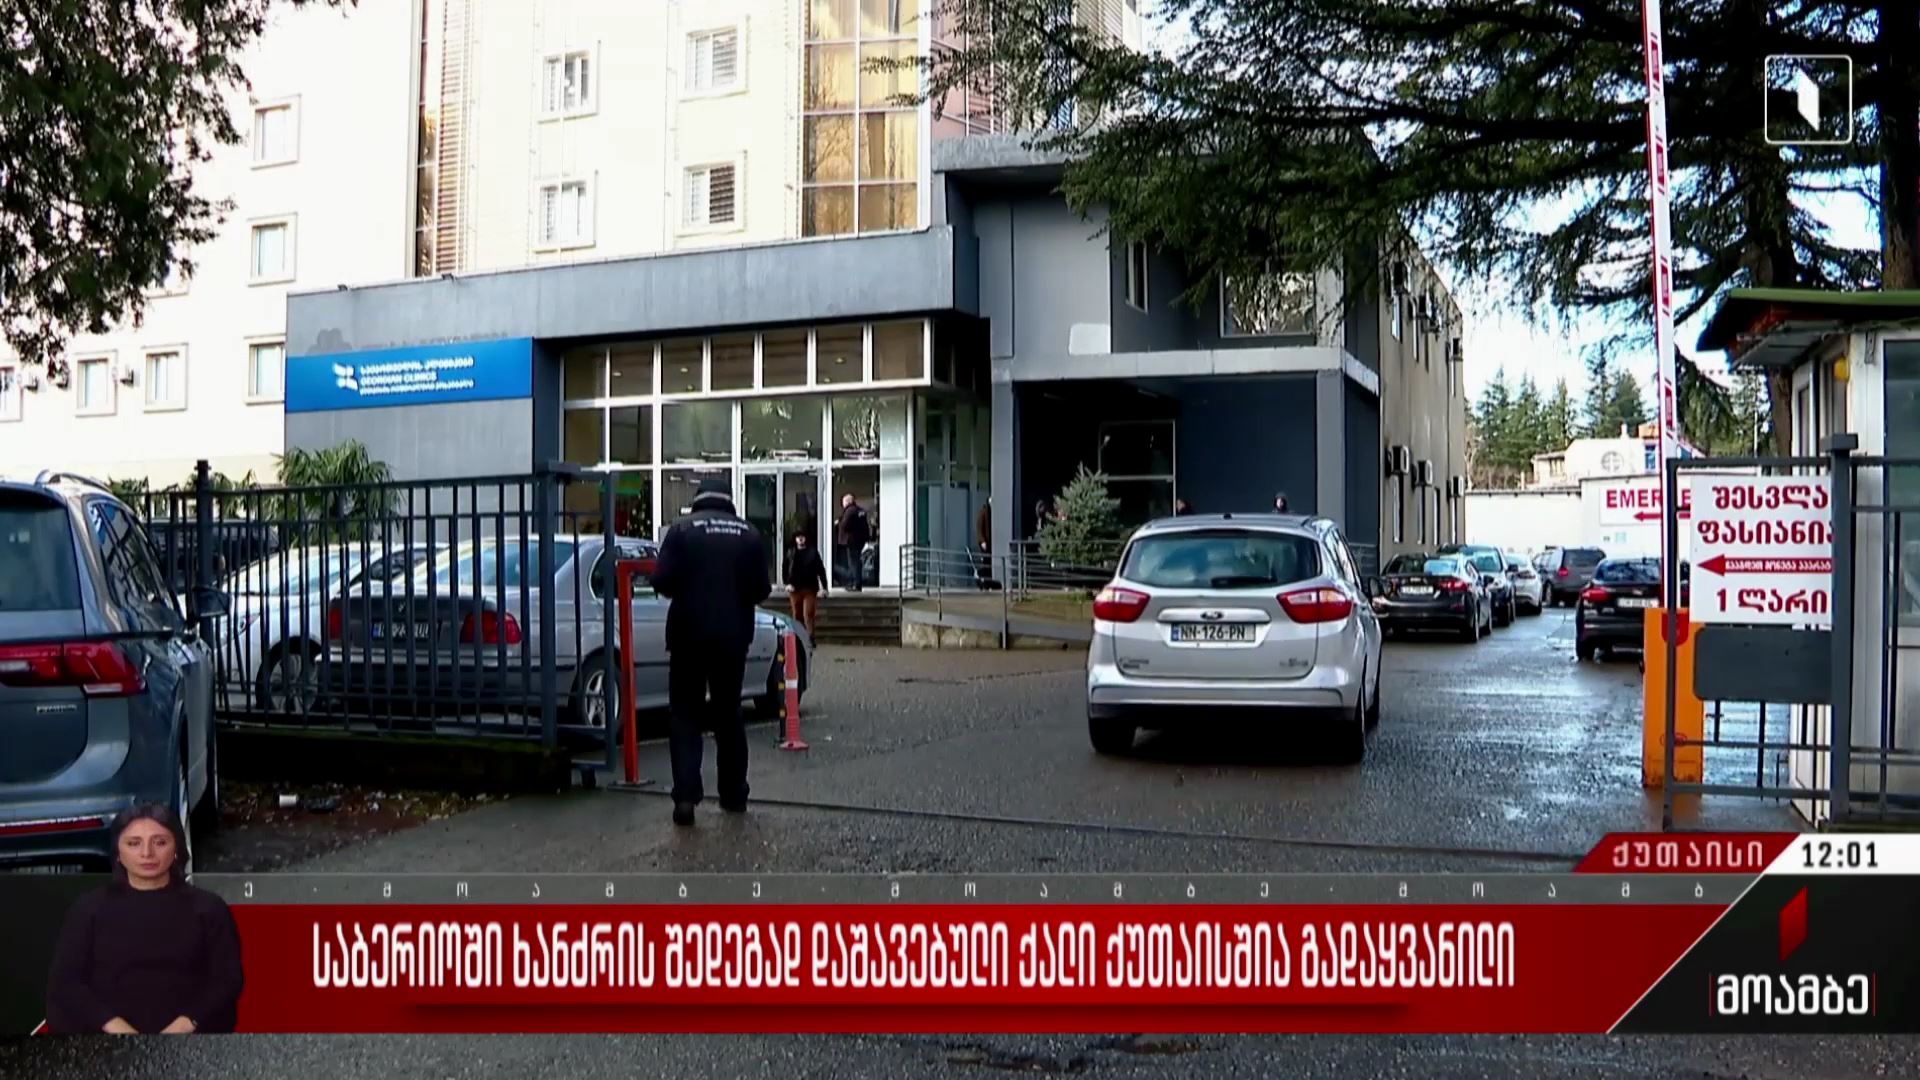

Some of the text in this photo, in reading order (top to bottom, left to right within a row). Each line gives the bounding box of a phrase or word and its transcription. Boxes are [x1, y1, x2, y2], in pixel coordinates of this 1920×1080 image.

[1711, 485, 1829, 510] შესვლა
[1716, 588, 1828, 613] 1 ლარი
[1180, 624, 1245, 640] NN-126-PN
